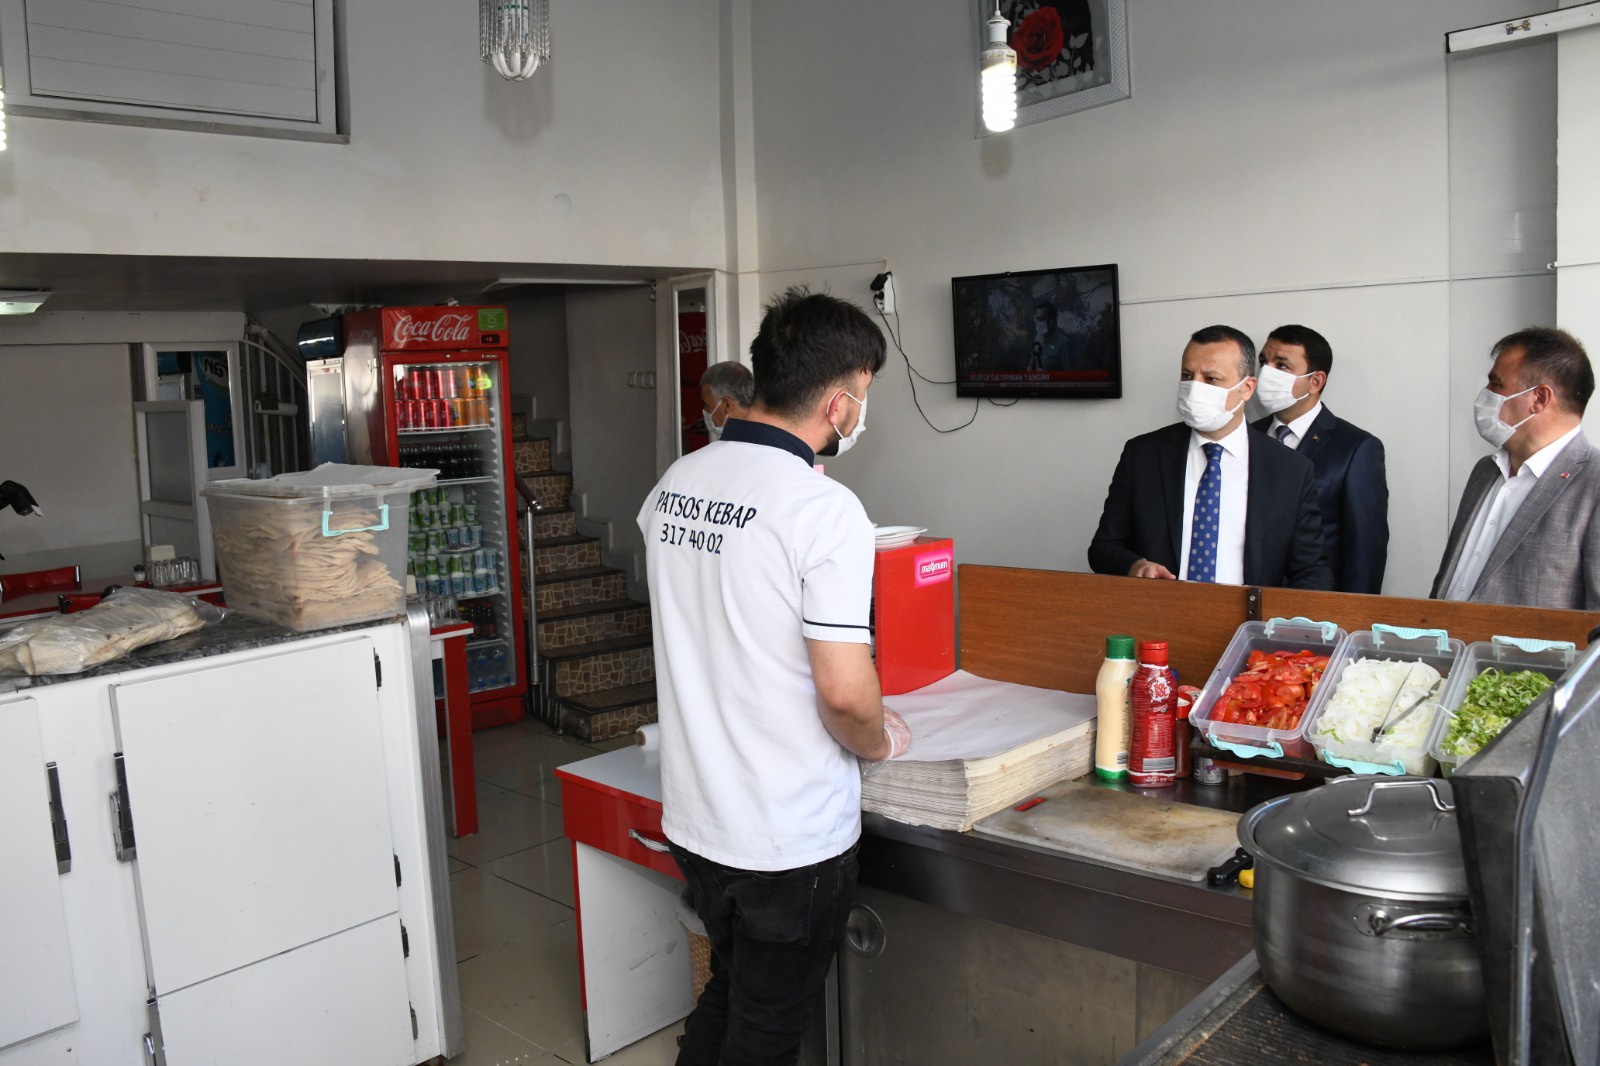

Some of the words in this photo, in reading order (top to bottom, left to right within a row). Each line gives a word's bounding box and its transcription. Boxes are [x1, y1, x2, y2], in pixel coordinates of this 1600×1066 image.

[970, 373, 999, 382] BURSA'DA
[1001, 373, 1023, 382] ORMAN
[1023, 373, 1050, 381] YANGINI
[655, 490, 704, 521] PATSOS
[703, 500, 757, 529] KEBAP
[660, 523, 686, 546] 317
[688, 529, 705, 551] 40
[706, 532, 723, 554] 02
